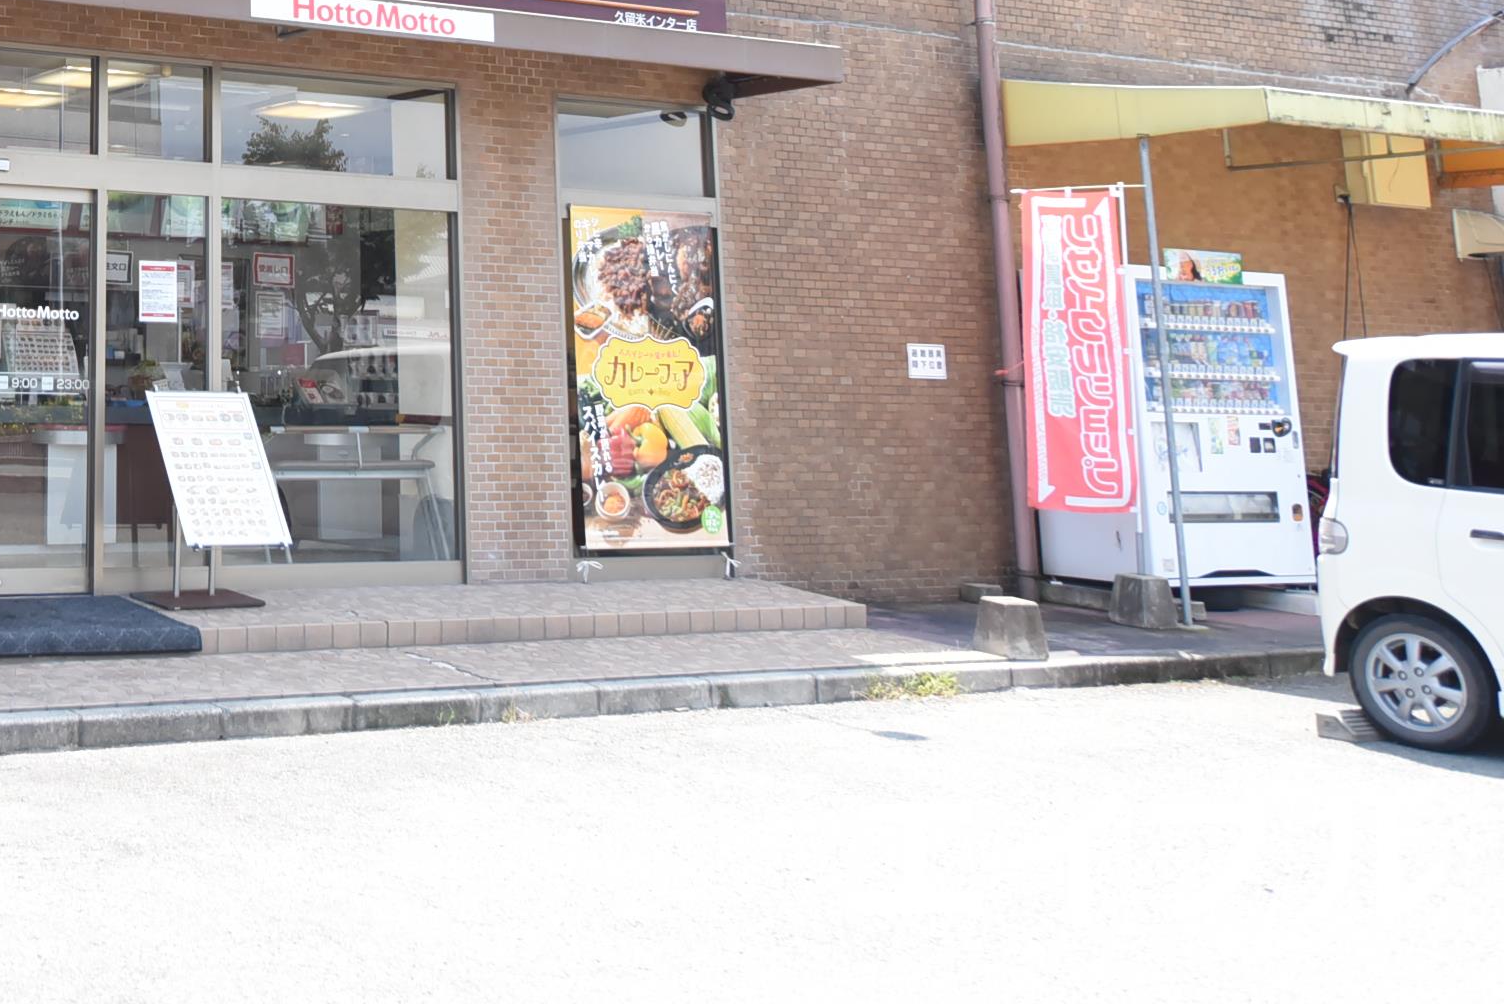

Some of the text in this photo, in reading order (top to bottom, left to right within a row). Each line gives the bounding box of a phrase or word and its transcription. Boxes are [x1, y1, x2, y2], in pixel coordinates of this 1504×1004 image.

[615, 10, 697, 31] 久留米インター店
[11, 377, 38, 389] 9:00
[56, 378, 90, 390] 23:00
[604, 355, 694, 392] カレーフェア
[582, 406, 605, 502] スパイスカレー
